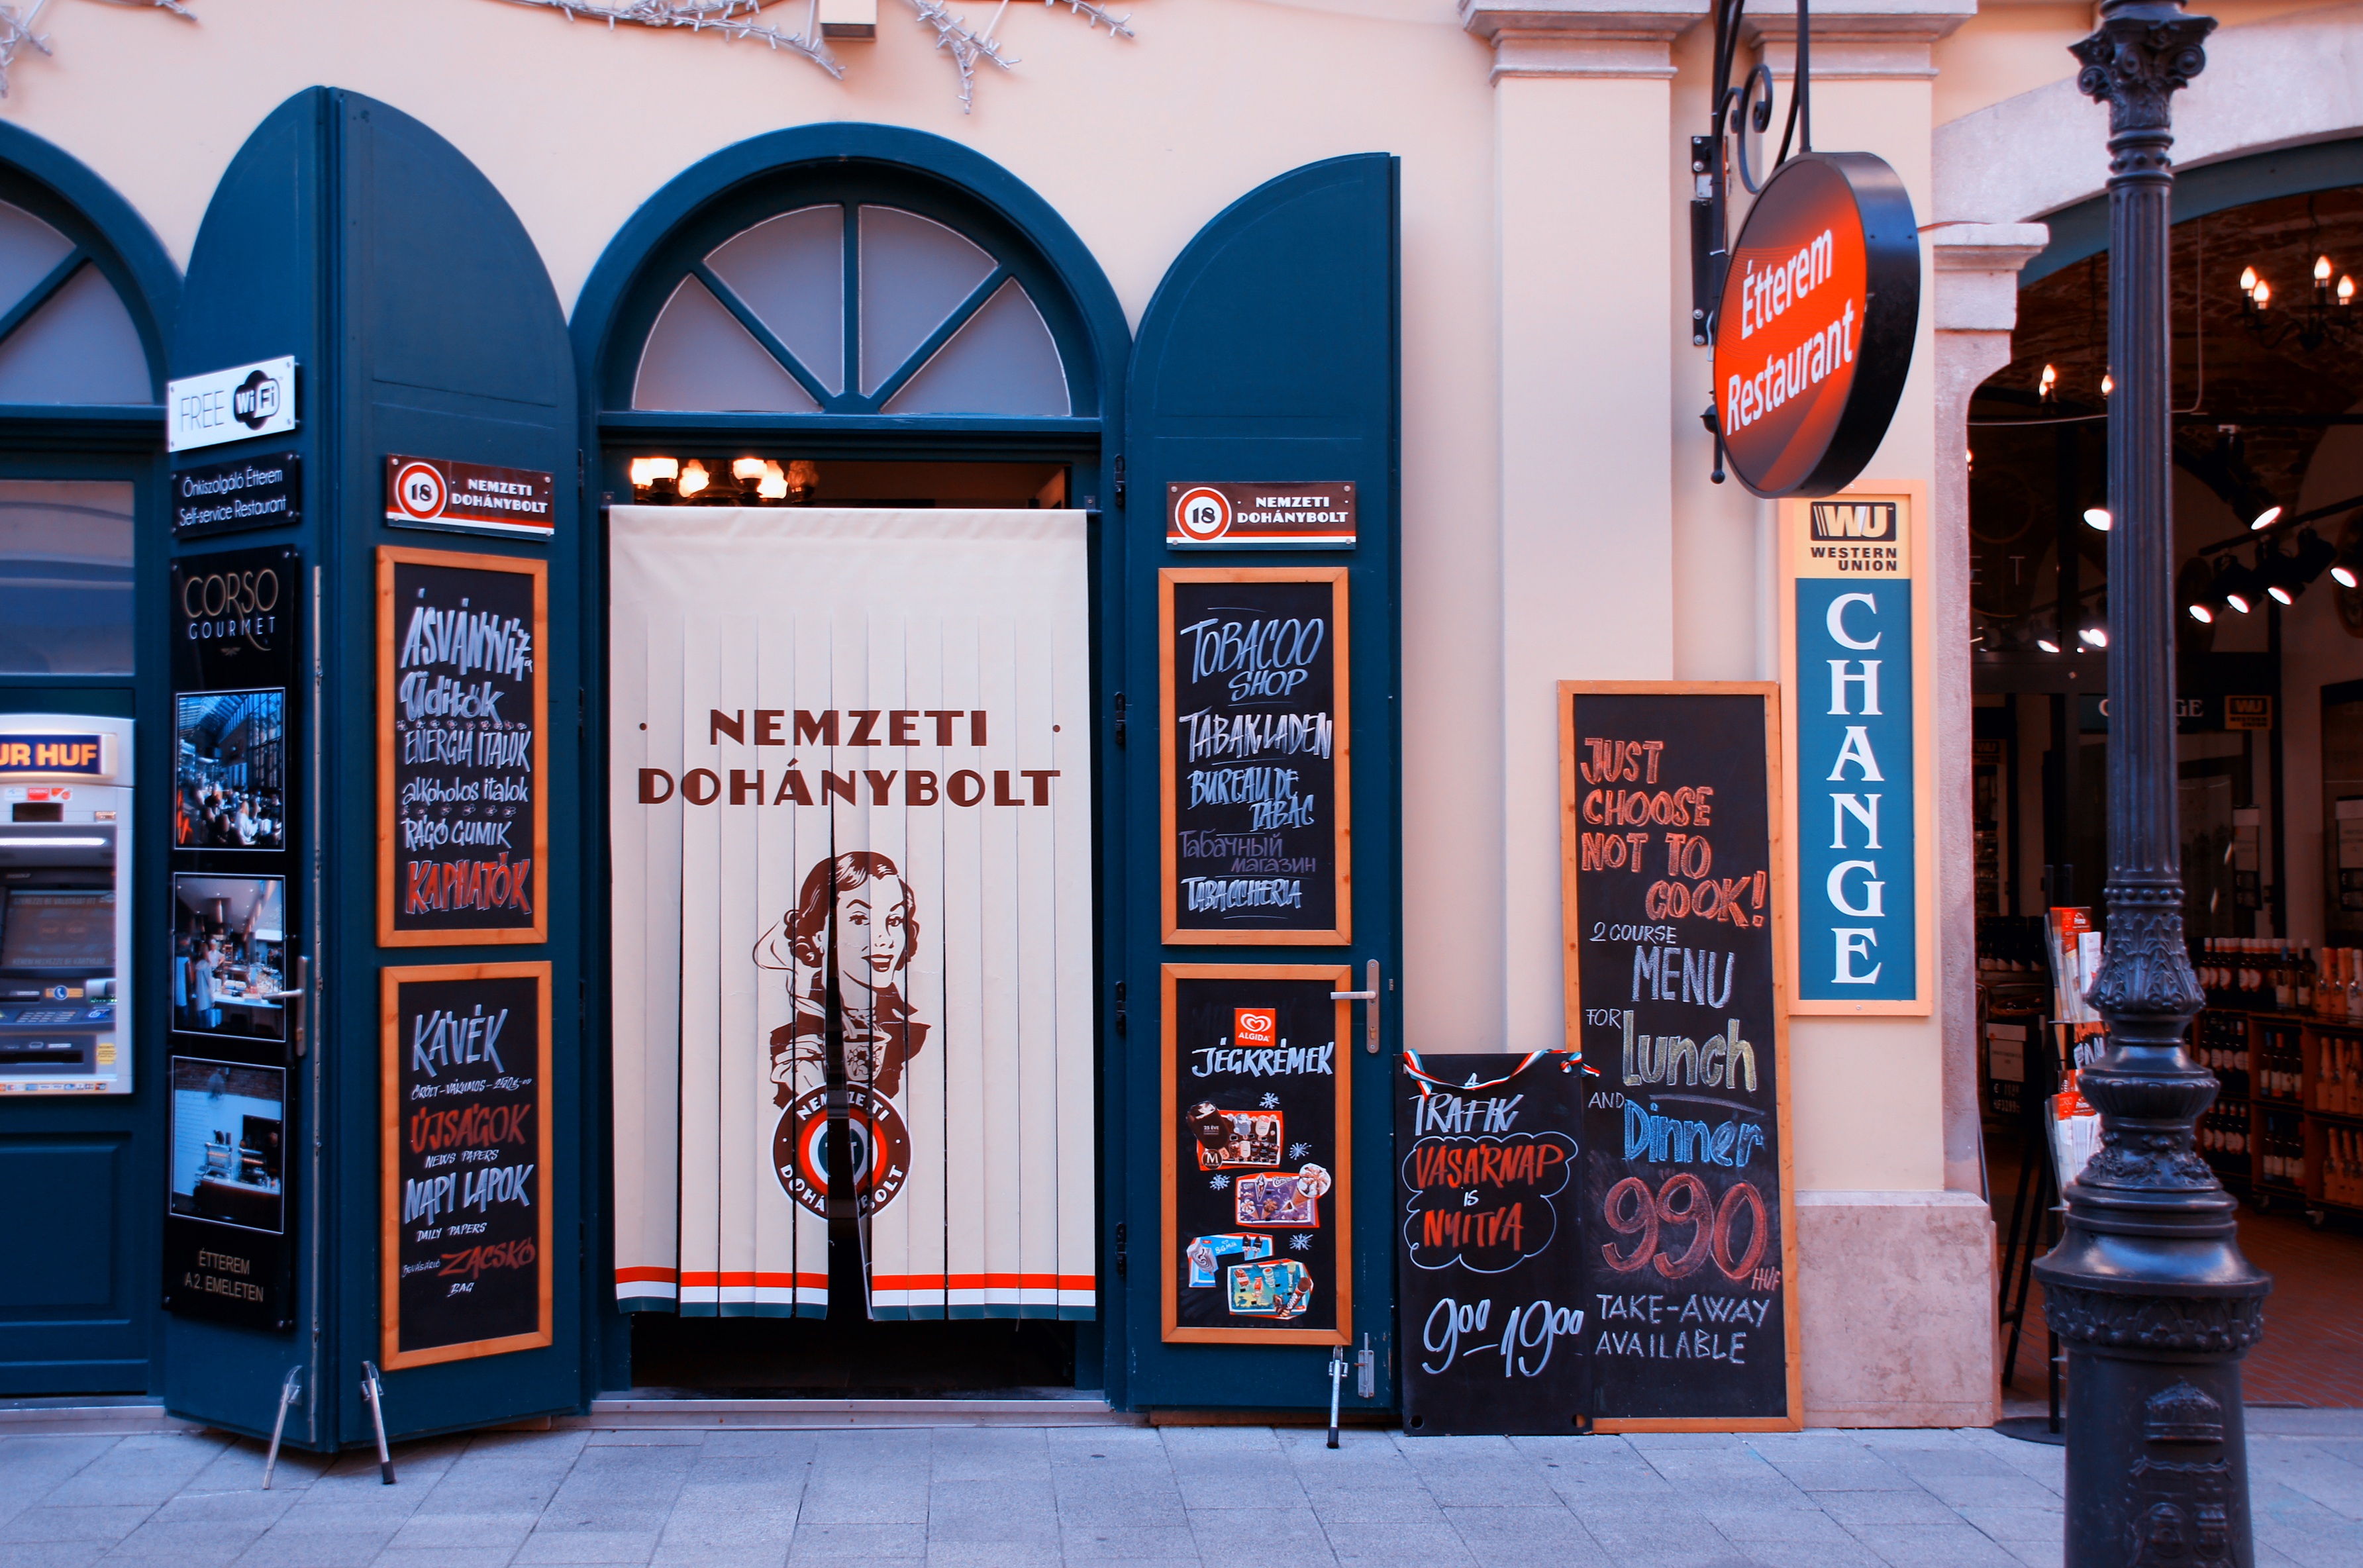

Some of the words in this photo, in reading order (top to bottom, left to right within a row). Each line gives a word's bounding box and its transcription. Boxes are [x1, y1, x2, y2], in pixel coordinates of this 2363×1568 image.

[1741, 229, 1833, 340] Étterem
[1725, 297, 1855, 436] Restaurant
[181, 389, 225, 432] FREE
[246, 466, 283, 488] Étterem
[411, 483, 432, 502] 18
[468, 479, 532, 497] NEMZETI
[179, 505, 232, 526] Self-service
[234, 495, 287, 518] Restaurant
[452, 493, 548, 514] DOHÁNYBOLT
[1192, 507, 1215, 524] 18
[1236, 509, 1348, 524] DOHÁNYBOLT
[1255, 496, 1330, 508] NEMZETI
[1813, 505, 1888, 538] WU
[1810, 547, 1897, 559] WESTERN
[1838, 560, 1897, 571] UNION
[184, 568, 279, 640] CORSO
[189, 616, 276, 640] GOURMET
[1227, 669, 1309, 702] SHOP
[709, 709, 988, 747] NEMZETI
[36, 743, 98, 766] HUF
[478, 730, 532, 772] ITALOK
[1580, 737, 1664, 785] JUST
[638, 757, 1061, 808] DOHÁNYBOLT
[1187, 766, 1272, 810] BUREAU
[1273, 766, 1300, 801] DE
[1825, 591, 1885, 985] CHANGE
[1248, 794, 1315, 832] TABAC
[1582, 785, 1714, 827] CHOOSE
[401, 814, 449, 852] RÁGÓ
[451, 820, 513, 849] GUMIK
[1178, 828, 1283, 858] Табачный
[1231, 857, 1317, 873] магазин
[1581, 832, 1649, 873] NOT
[1664, 832, 1712, 880] TO
[405, 851, 532, 915] KAPHATÓK
[1180, 876, 1303, 912] TABACCHERIA
[1644, 869, 1767, 928] COOK!
[1589, 921, 1606, 942] 2
[1608, 924, 1678, 944] COURSE
[1631, 945, 1736, 1008] MENU
[1585, 1008, 1621, 1030] FOR
[413, 1004, 508, 1078] KÁVÉK
[1238, 1031, 1270, 1043] ALGIDA
[1191, 1036, 1335, 1078] JÉGKRÉMEK
[1464, 1072, 1480, 1089] A
[1408, 1092, 1525, 1137] TRAFIK
[1587, 1091, 1626, 1109] AND
[411, 1102, 531, 1154] ÚJSÁGOK
[1621, 1098, 1766, 1167] Dinner
[425, 1152, 457, 1169] NEWS
[462, 1149, 499, 1163] PAPERS
[1415, 1143, 1564, 1189] VASÁRNAP
[405, 1171, 457, 1226] NAPI
[463, 1163, 534, 1214] LAPOK
[1463, 1189, 1480, 1207] IS
[417, 1227, 442, 1243] DAILY
[448, 1222, 487, 1237] PAPERS
[1424, 1202, 1525, 1251] NYITVA
[1601, 1172, 1767, 1280] 990
[199, 1247, 250, 1275] ÉTTEREM
[437, 1236, 536, 1280] ZACSKÓ
[205, 1275, 264, 1302] EMELETEN
[446, 1281, 475, 1298] BAG
[1751, 1265, 1782, 1291] HUF
[1595, 1294, 1770, 1328] TAKE-AWAY
[1595, 1328, 1747, 1364] AVAILABLE
